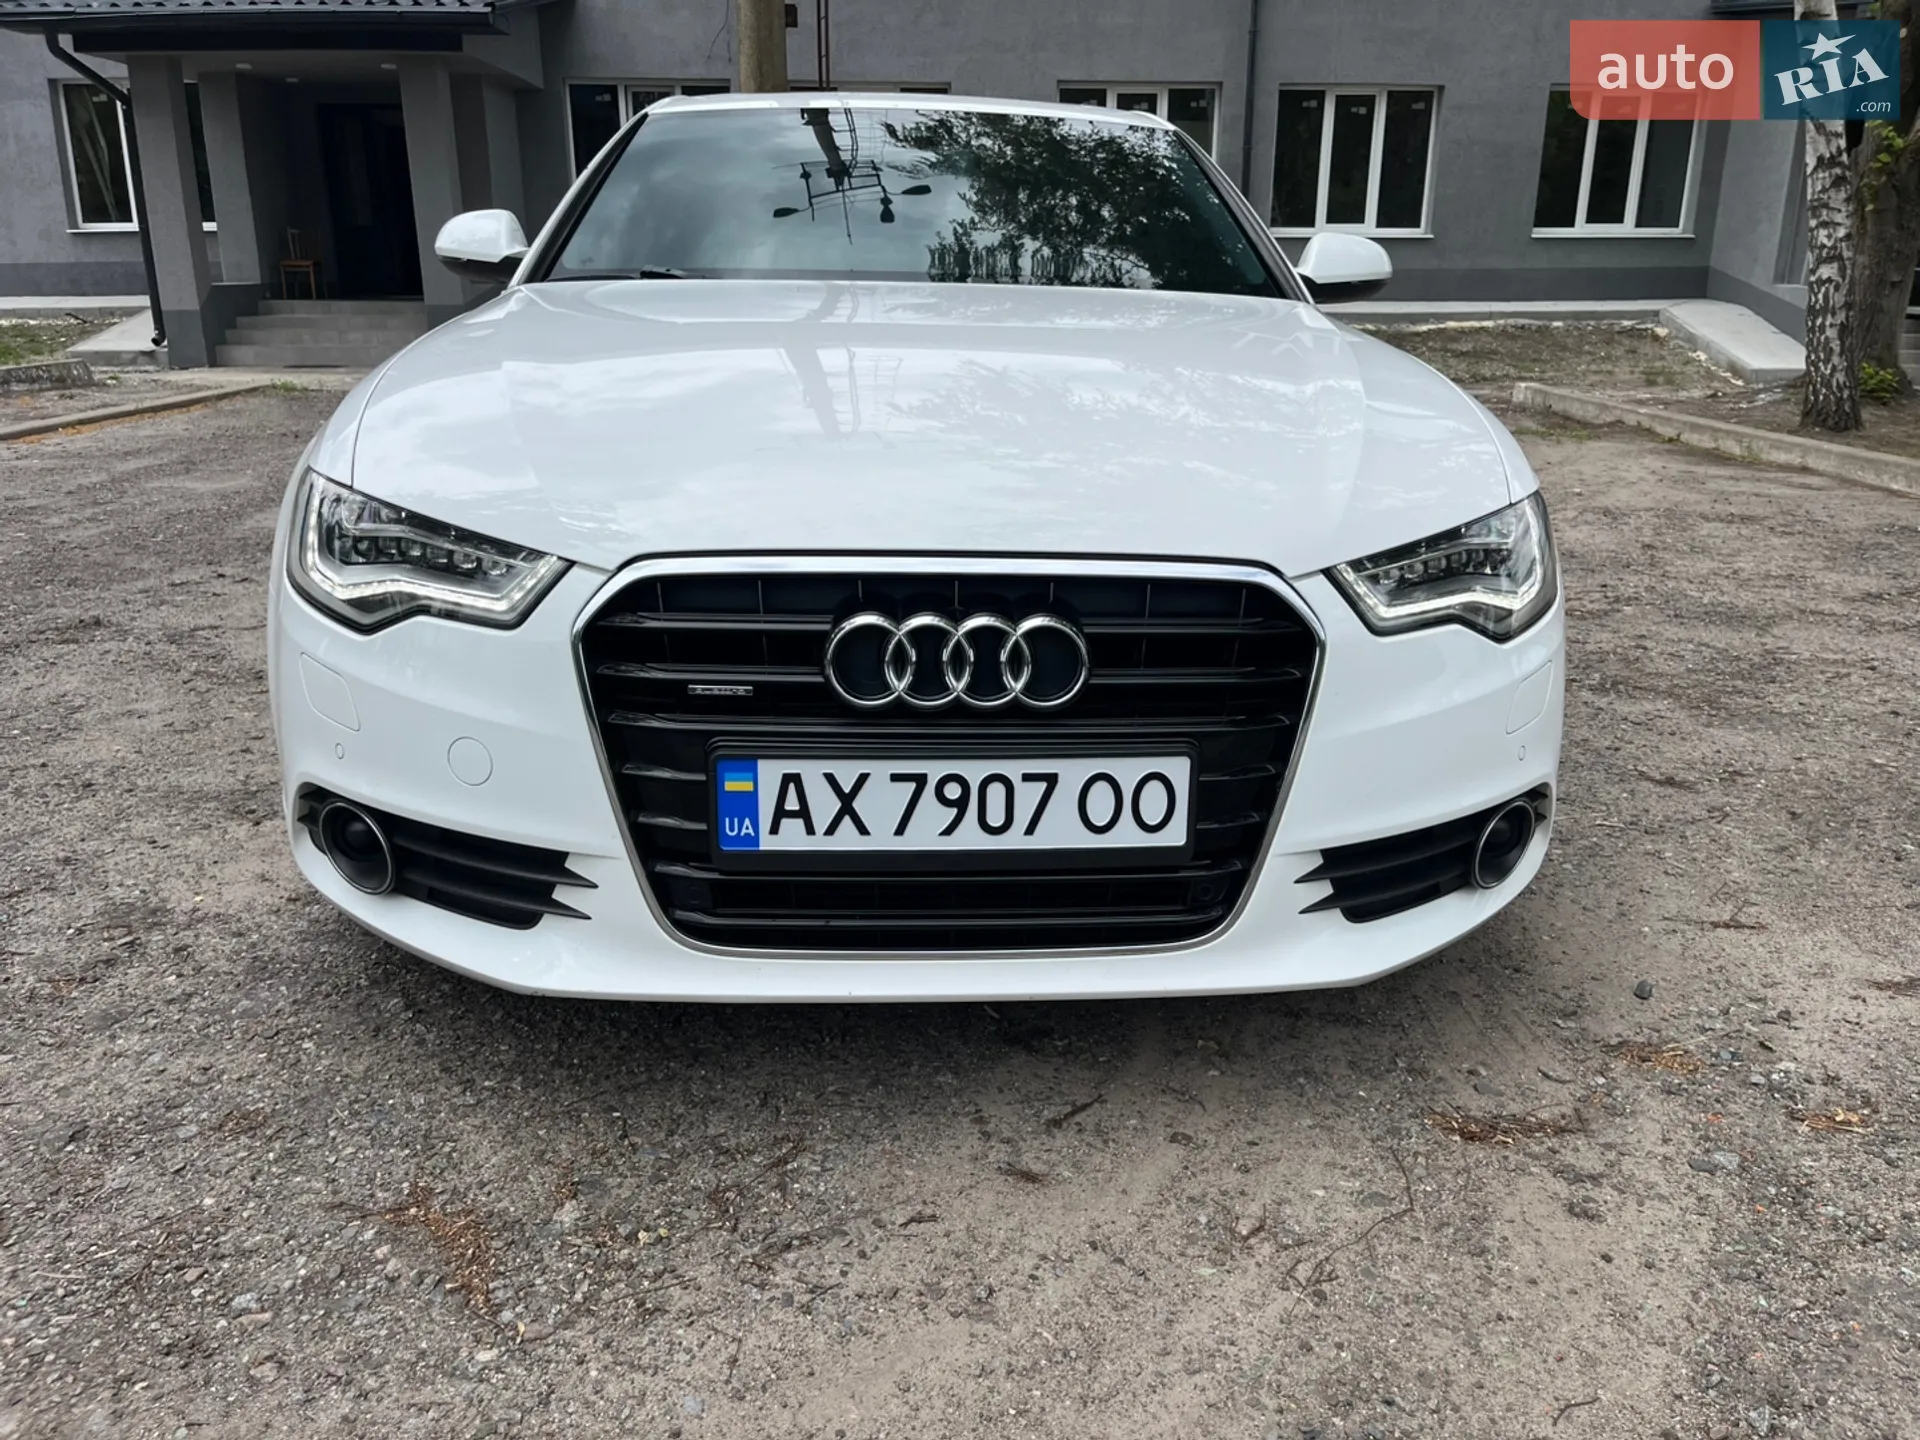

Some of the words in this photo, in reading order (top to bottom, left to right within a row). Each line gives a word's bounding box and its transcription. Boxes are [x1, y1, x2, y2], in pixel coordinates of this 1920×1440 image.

[768, 772, 871, 836] AX
[889, 772, 1059, 836] 7907
[724, 817, 755, 837] UA
